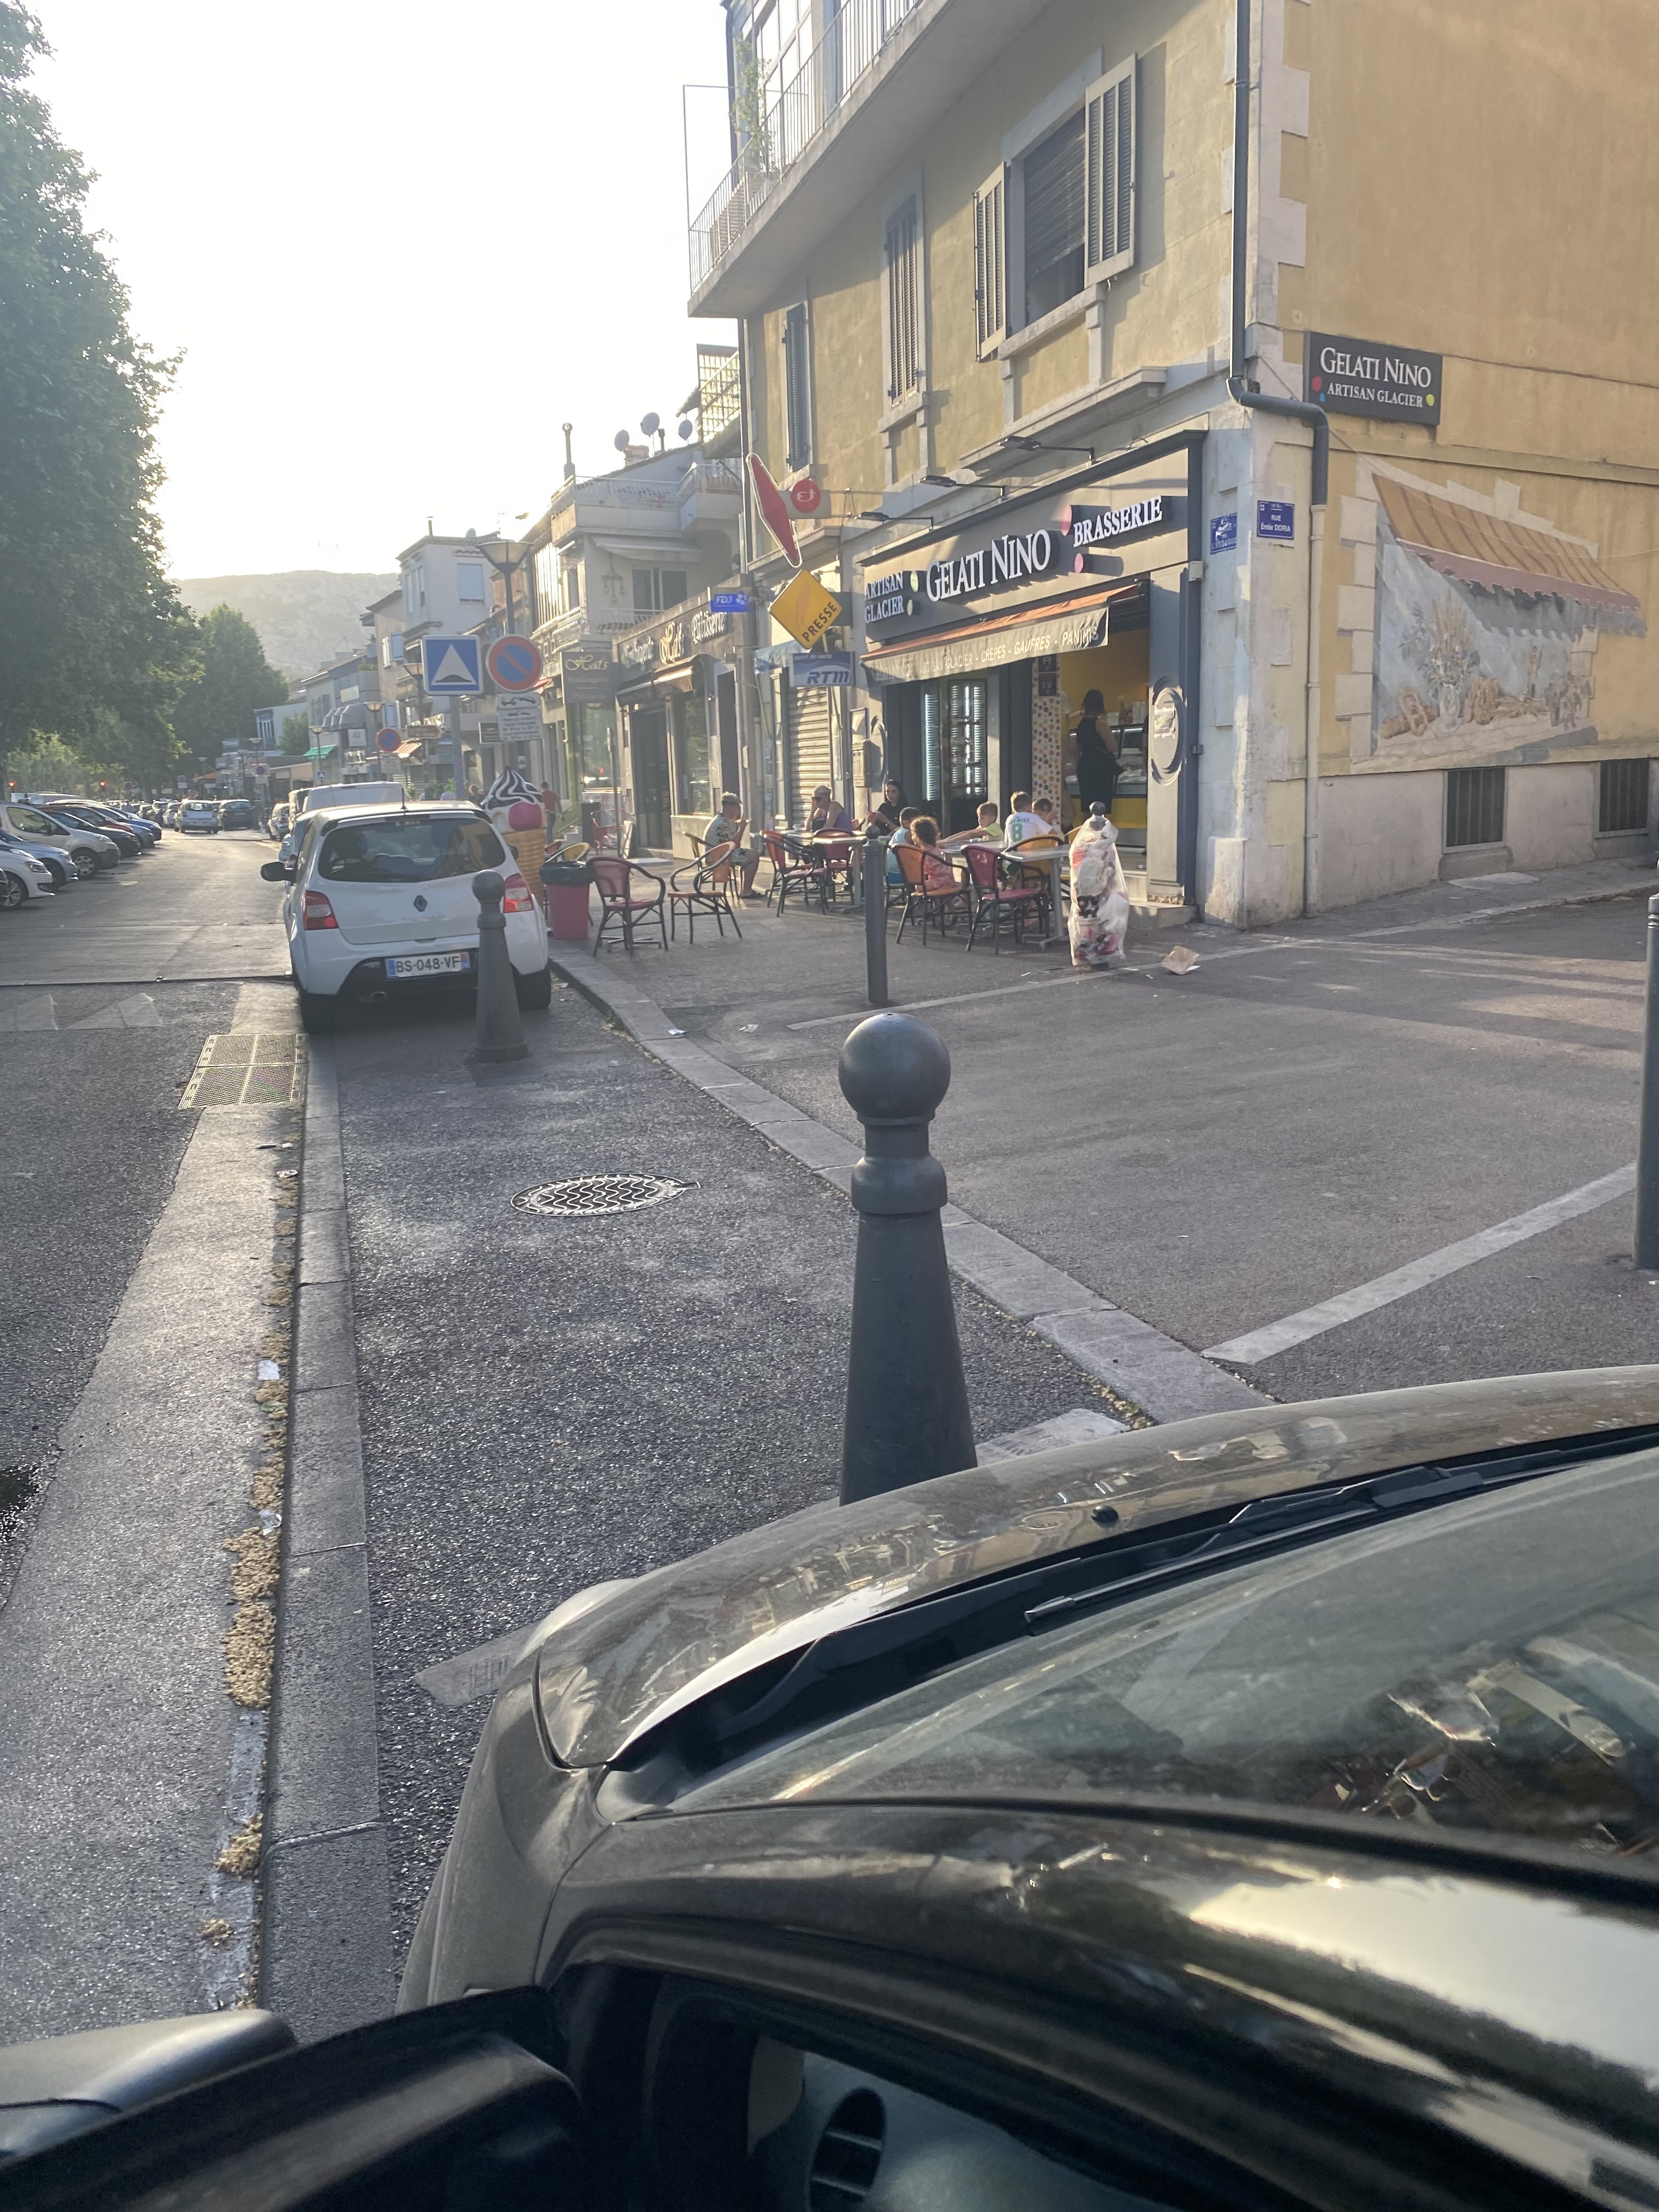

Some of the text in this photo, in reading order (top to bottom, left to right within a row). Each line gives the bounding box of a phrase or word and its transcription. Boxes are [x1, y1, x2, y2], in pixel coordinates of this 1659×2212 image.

[1320, 347, 1432, 388] GELATI NINO
[1327, 382, 1423, 408] ARTISAN GLACIER
[1073, 495, 1163, 548] BRASSERIE
[926, 529, 1051, 602] GELATI NINO
[715, 596, 732, 604] FDJ
[864, 572, 903, 601] ARTISAN
[802, 601, 838, 642] PRESSE
[864, 595, 905, 624] GLACIER
[945, 653, 973, 673] GLACIER
[981, 645, 1006, 663] CREPES
[1014, 635, 1051, 655] GAUFRES
[1012, 822, 1023, 842] 8
[396, 956, 460, 973] BS-048-VF
